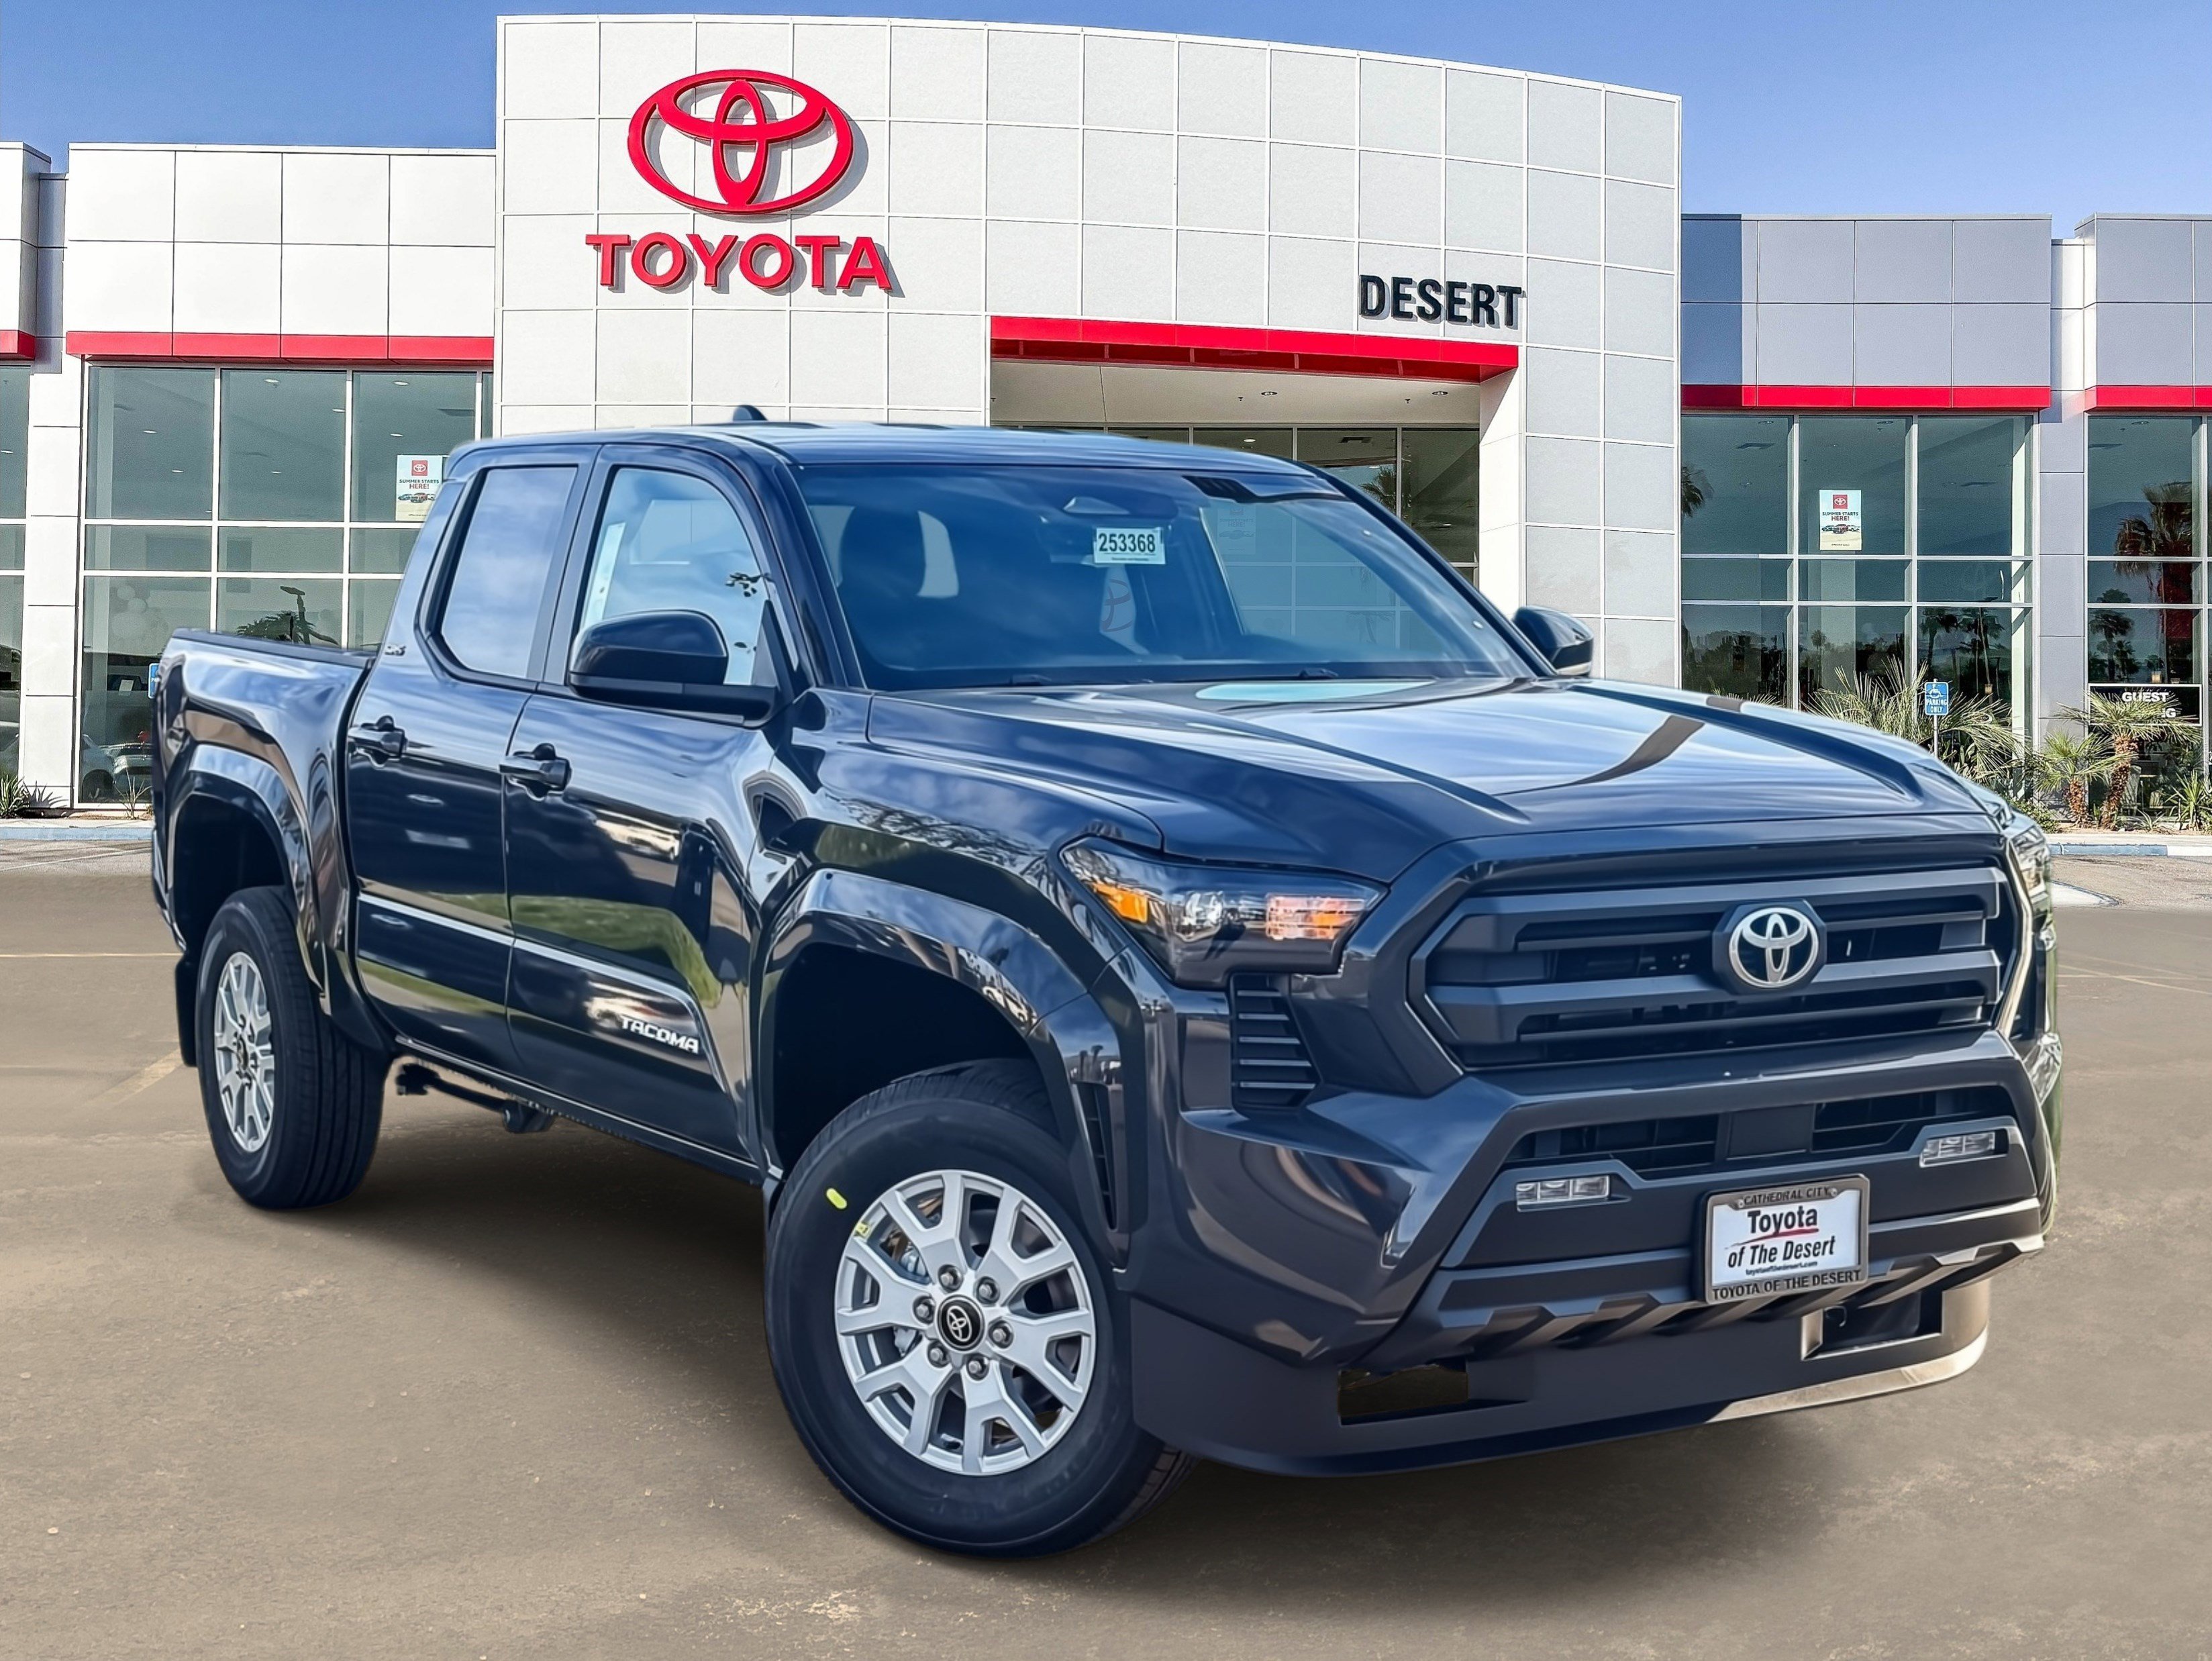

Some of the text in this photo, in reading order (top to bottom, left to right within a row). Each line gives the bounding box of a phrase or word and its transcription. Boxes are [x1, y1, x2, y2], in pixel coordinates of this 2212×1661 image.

[586, 232, 893, 293] TOYOTA
[1359, 274, 1522, 327] DESERT
[1099, 532, 1156, 553] 253368
[2122, 691, 2169, 703] GUEST
[620, 1014, 699, 1054] TACOMA
[1744, 1187, 1830, 1205] CATHEDRAL CITY
[1748, 1205, 1818, 1234] Toyota
[1728, 1236, 1836, 1268] of The Desert
[1713, 1269, 1862, 1301] TOYOTA OF THE DESERT
